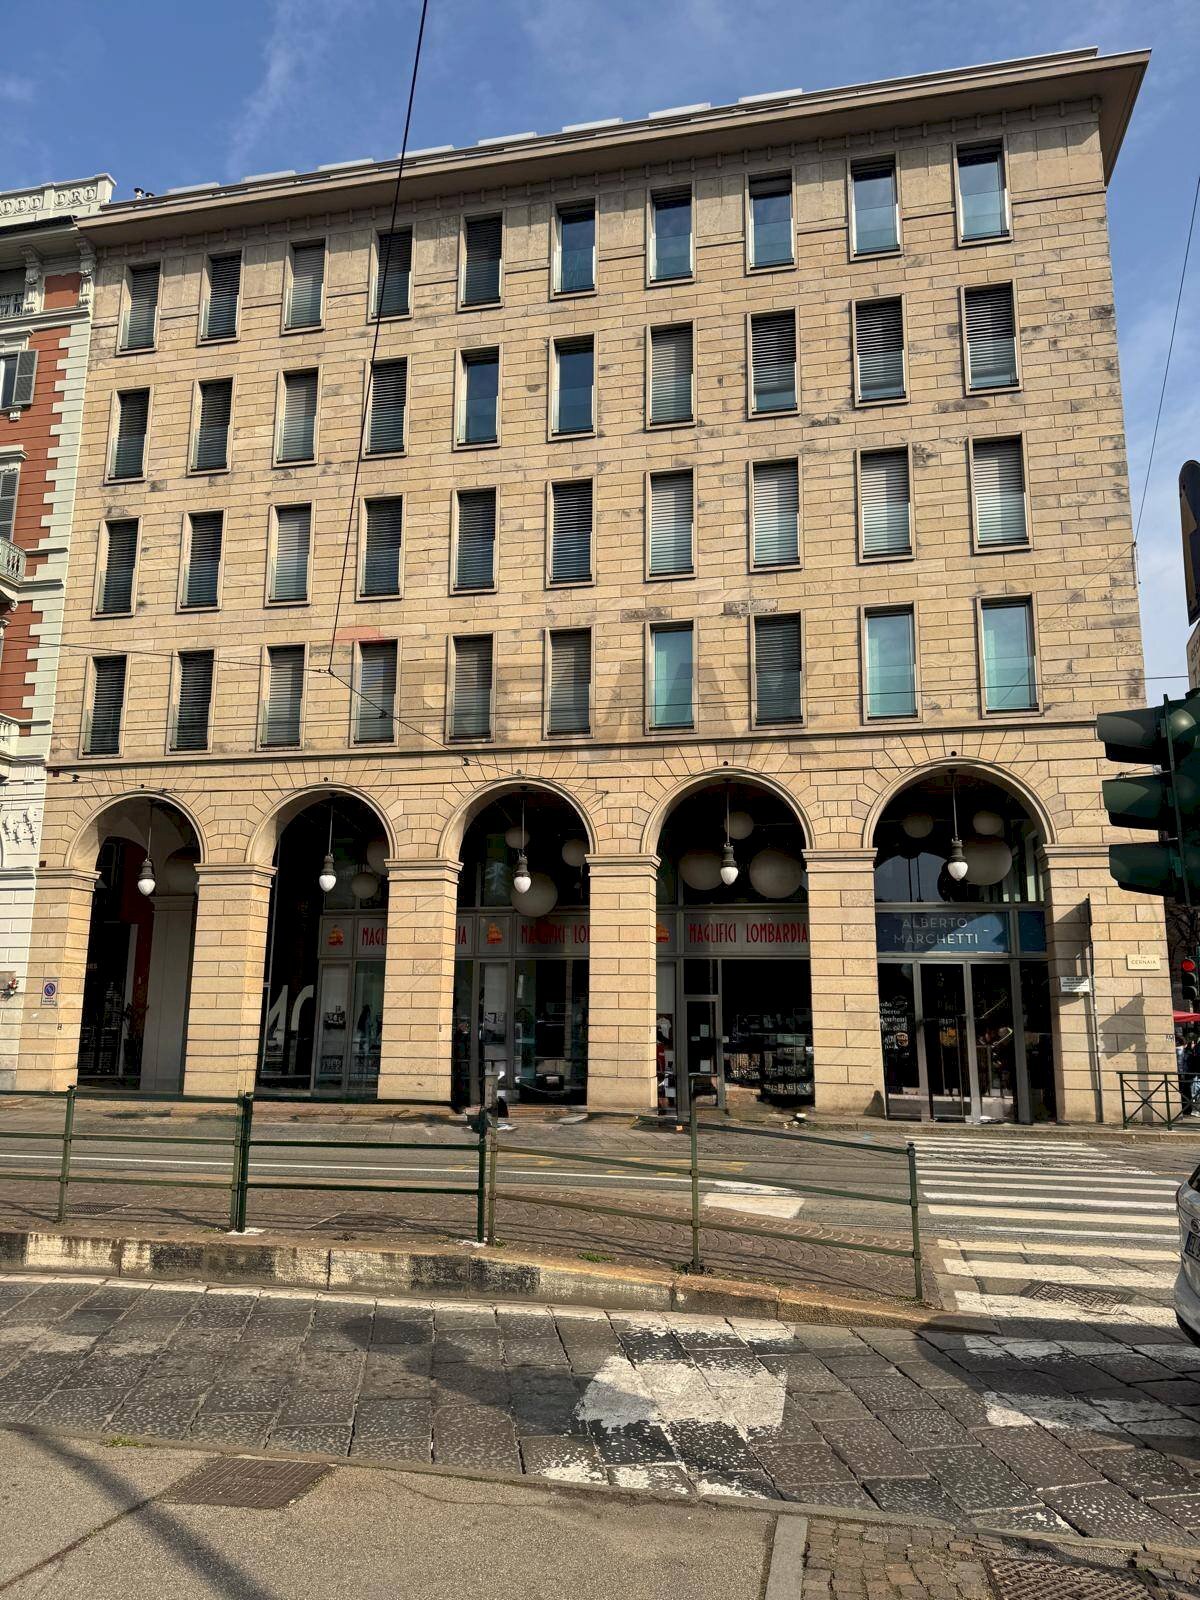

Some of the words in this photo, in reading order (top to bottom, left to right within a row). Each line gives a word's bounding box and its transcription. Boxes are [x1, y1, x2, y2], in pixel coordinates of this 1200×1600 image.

[902, 918, 968, 928] ALBERTO
[574, 924, 590, 944] LO
[688, 922, 737, 943] MAGLIFICI
[746, 922, 809, 943] LOMBARDIA
[894, 933, 978, 944] MARCHETTI
